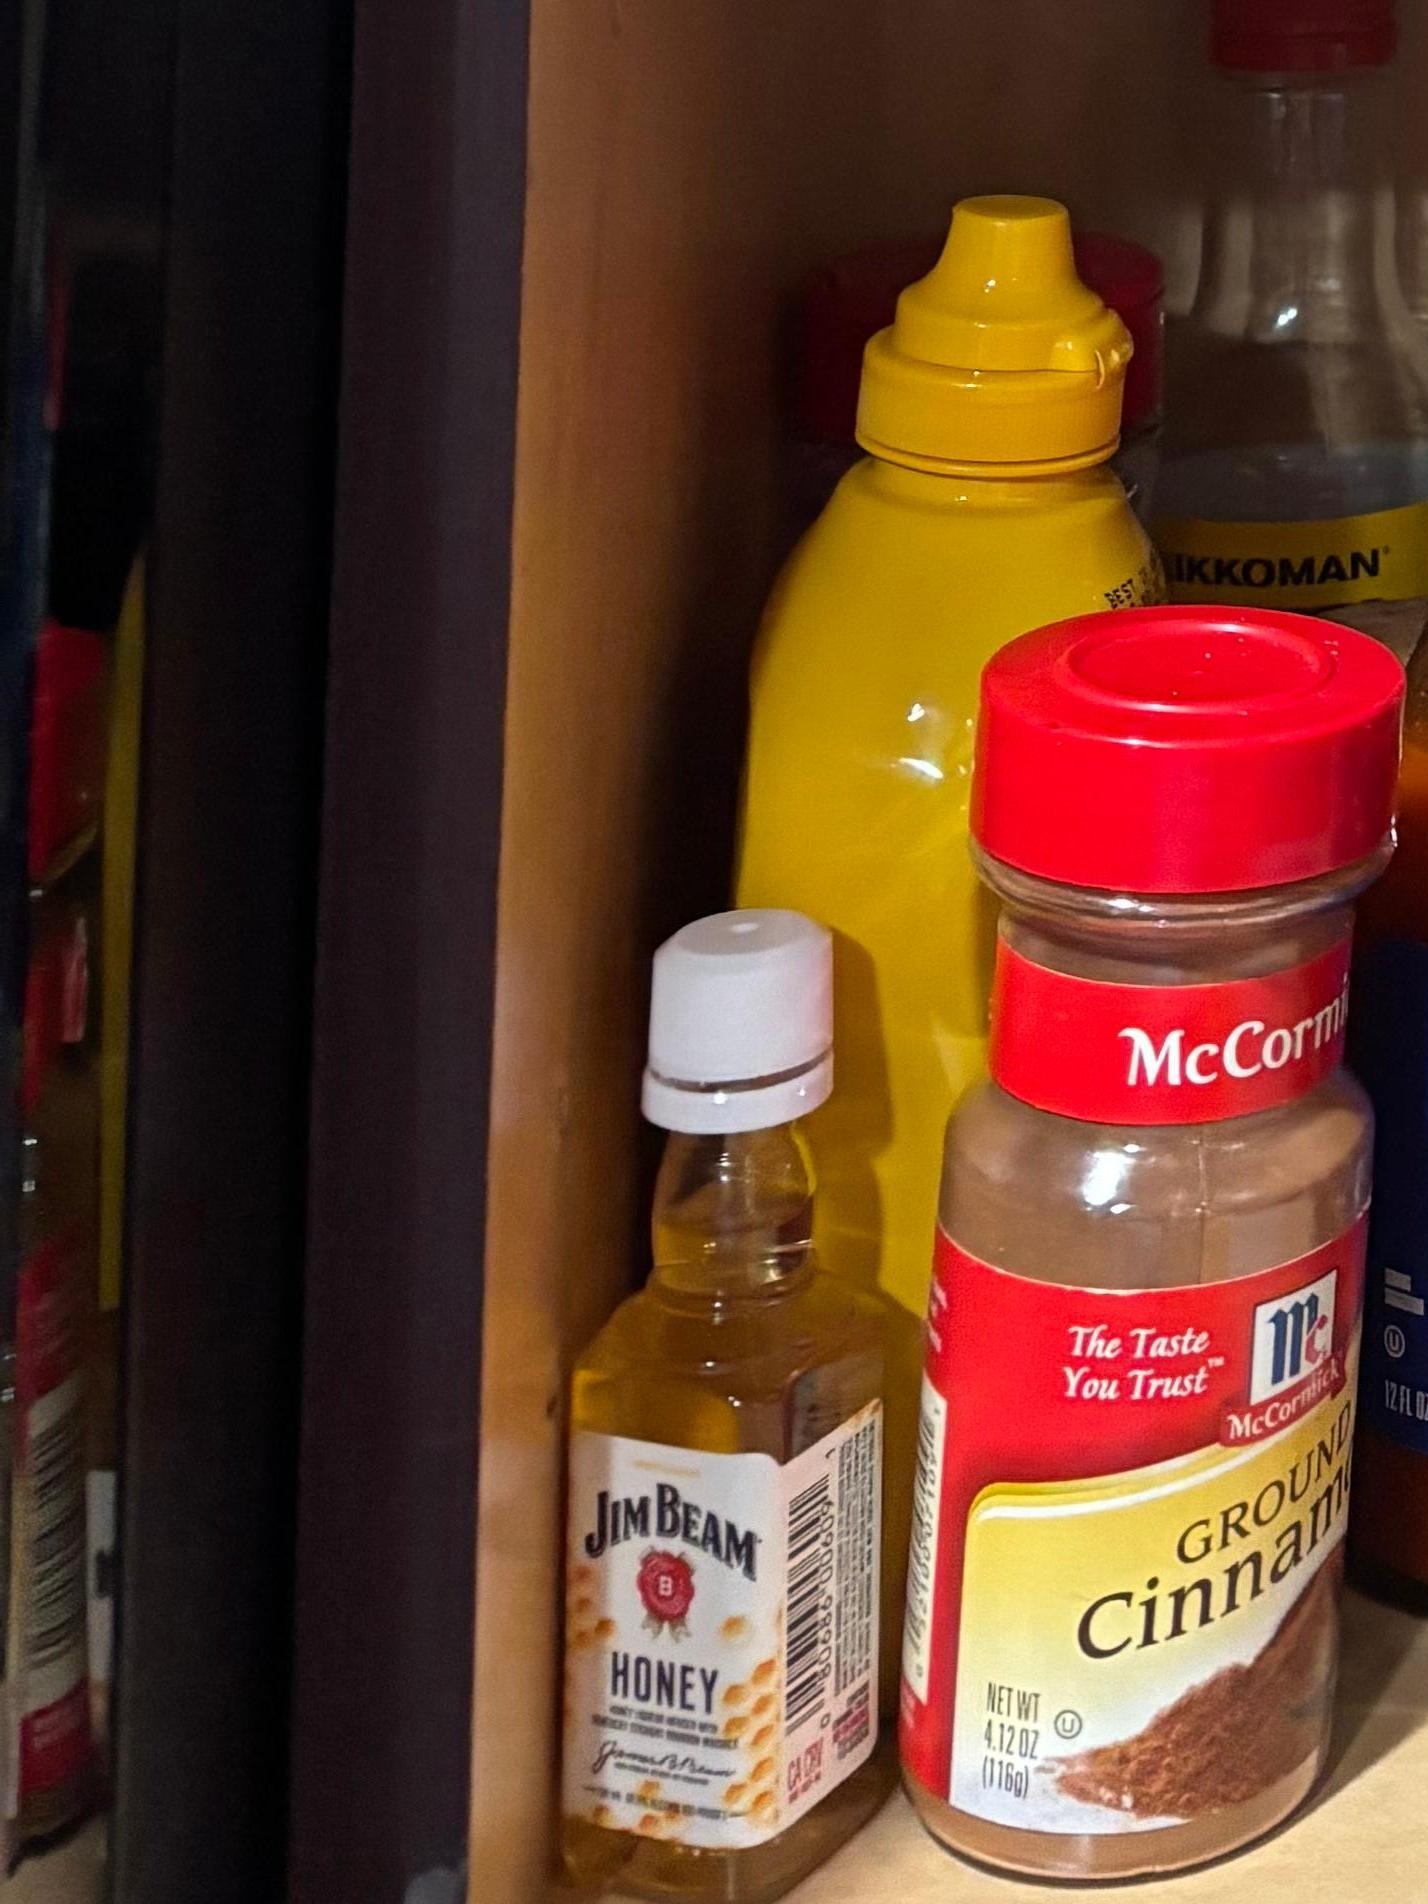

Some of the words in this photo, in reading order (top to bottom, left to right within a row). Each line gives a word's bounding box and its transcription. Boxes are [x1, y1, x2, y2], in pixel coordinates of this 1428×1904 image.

[1118, 974, 1349, 1085] McCormi
[1068, 1325, 1122, 1359] The
[1130, 1325, 1210, 1359] Taste
[1063, 1365, 1119, 1401] You
[1227, 1363, 1342, 1440] McCormick
[1177, 1402, 1350, 1565] GROUND
[585, 1490, 651, 1559] JIM
[656, 1482, 757, 1582] BEAM
[1077, 1468, 1351, 1659] Cinnam
[610, 1650, 719, 1716] HONEY
[986, 1682, 1014, 1712] NET
[1017, 1691, 1041, 1724] WT
[983, 1721, 1017, 1756] 4.12
[981, 1758, 1030, 1799] (116g)
